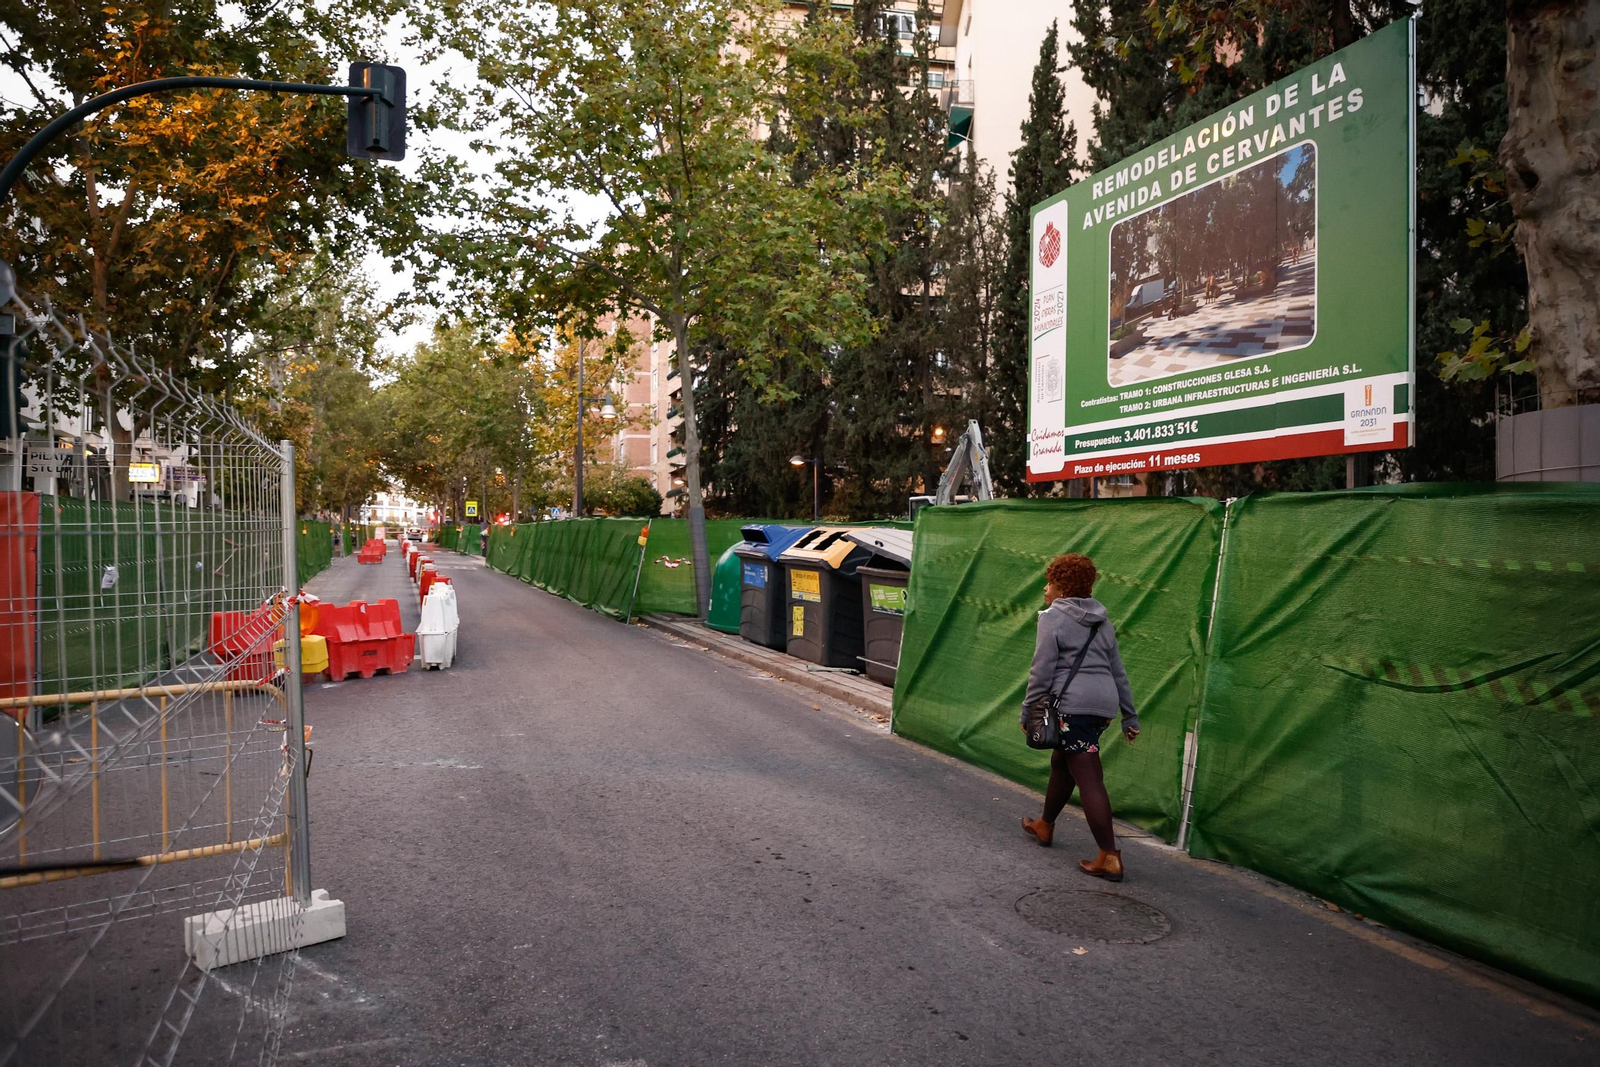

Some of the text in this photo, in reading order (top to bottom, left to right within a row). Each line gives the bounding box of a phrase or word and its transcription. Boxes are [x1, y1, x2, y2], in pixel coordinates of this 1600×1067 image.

[1092, 62, 1347, 200] REMODELACIÓN DE LA
[1083, 88, 1364, 230] AVENIDA DE CERVANTES
[1080, 364, 1272, 408] Contratistas: TRAMO 1: CONSTRUCCIONES GLESA S.A.
[1119, 363, 1363, 413] TRAMO 2: URBANA INFRAESTRUCTURAS E INGENIERÍA S.L.
[1350, 406, 1387, 418] GRANADA
[1360, 418, 1377, 427] 2031
[1031, 427, 1065, 442] Cuidamos
[1075, 435, 1122, 449] Presupuesto:
[1033, 441, 1062, 457] Granada
[1074, 452, 1201, 474] Plazo de ejecución: 11 meses
